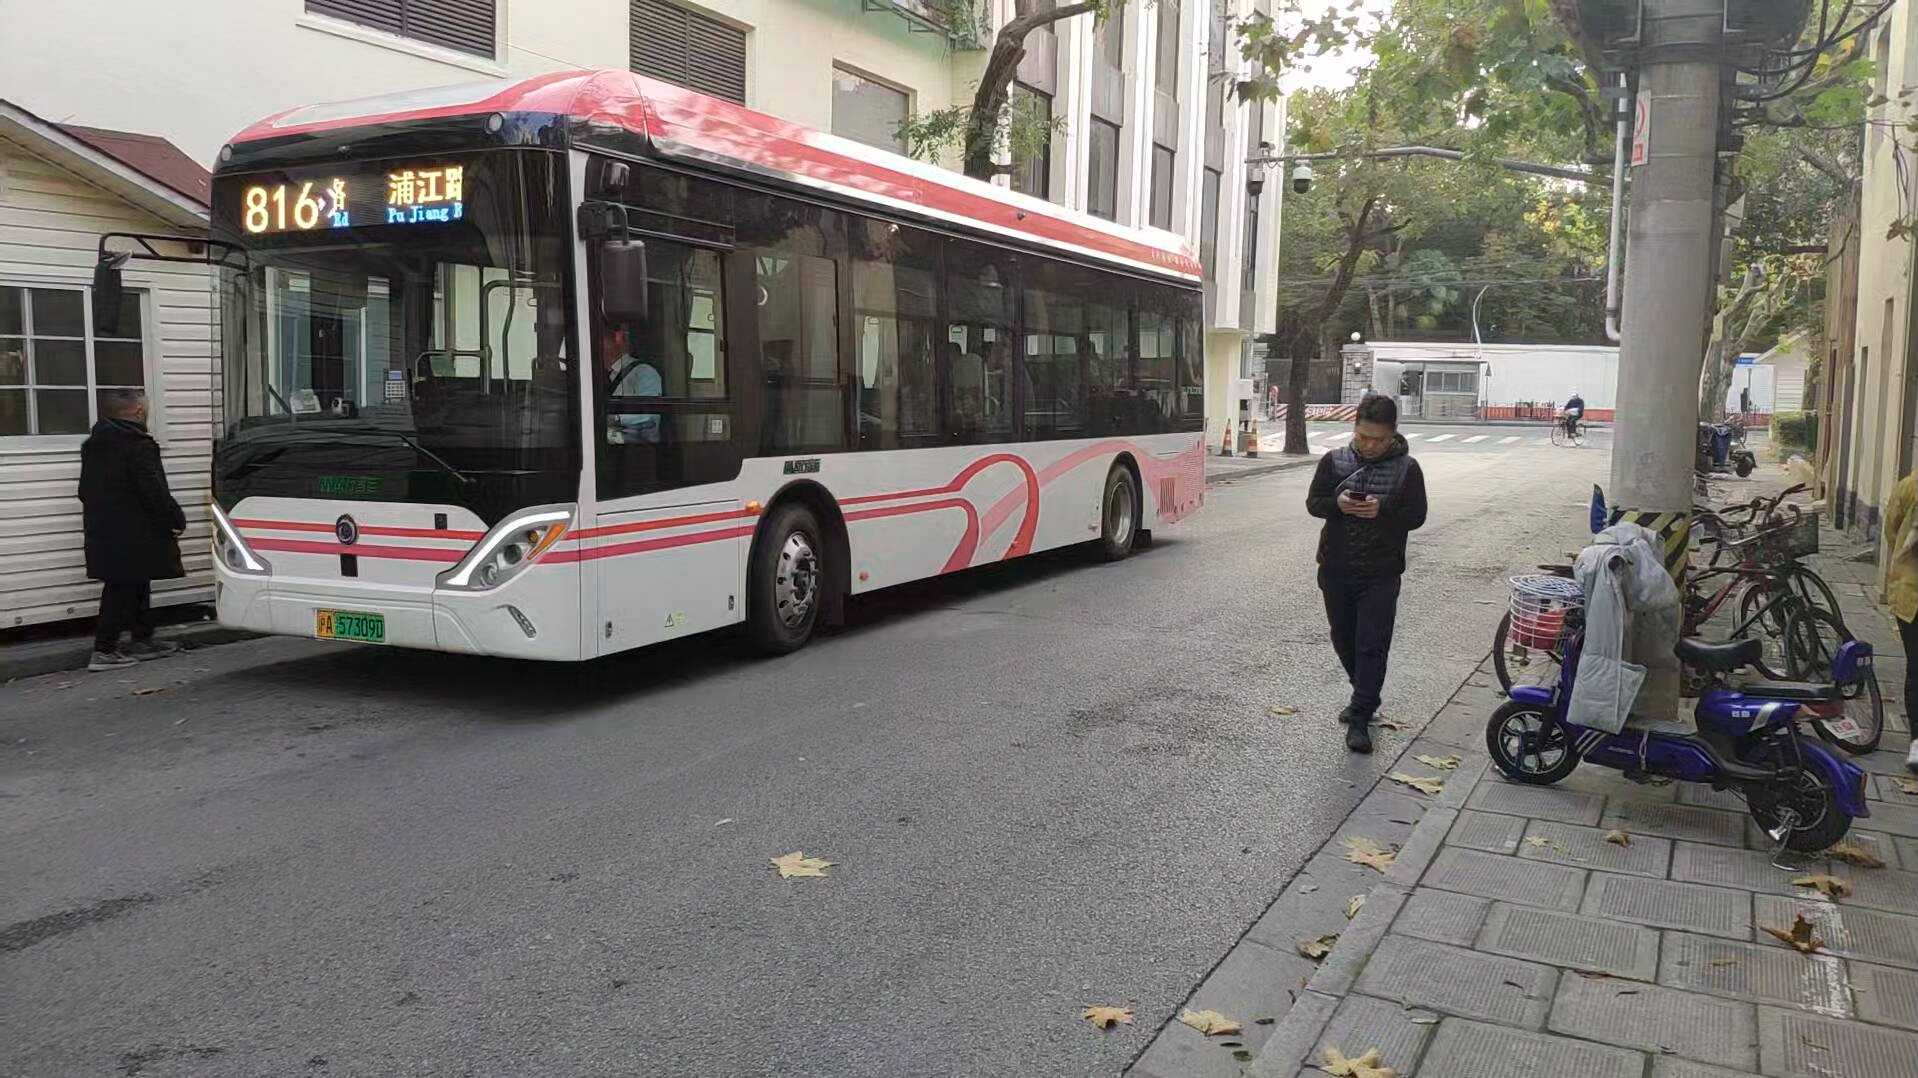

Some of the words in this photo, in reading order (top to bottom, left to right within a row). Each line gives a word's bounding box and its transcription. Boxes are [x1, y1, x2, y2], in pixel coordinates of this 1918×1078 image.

[246, 182, 319, 233] 816
[388, 207, 405, 223] Pu
[409, 205, 449, 223] Jiang
